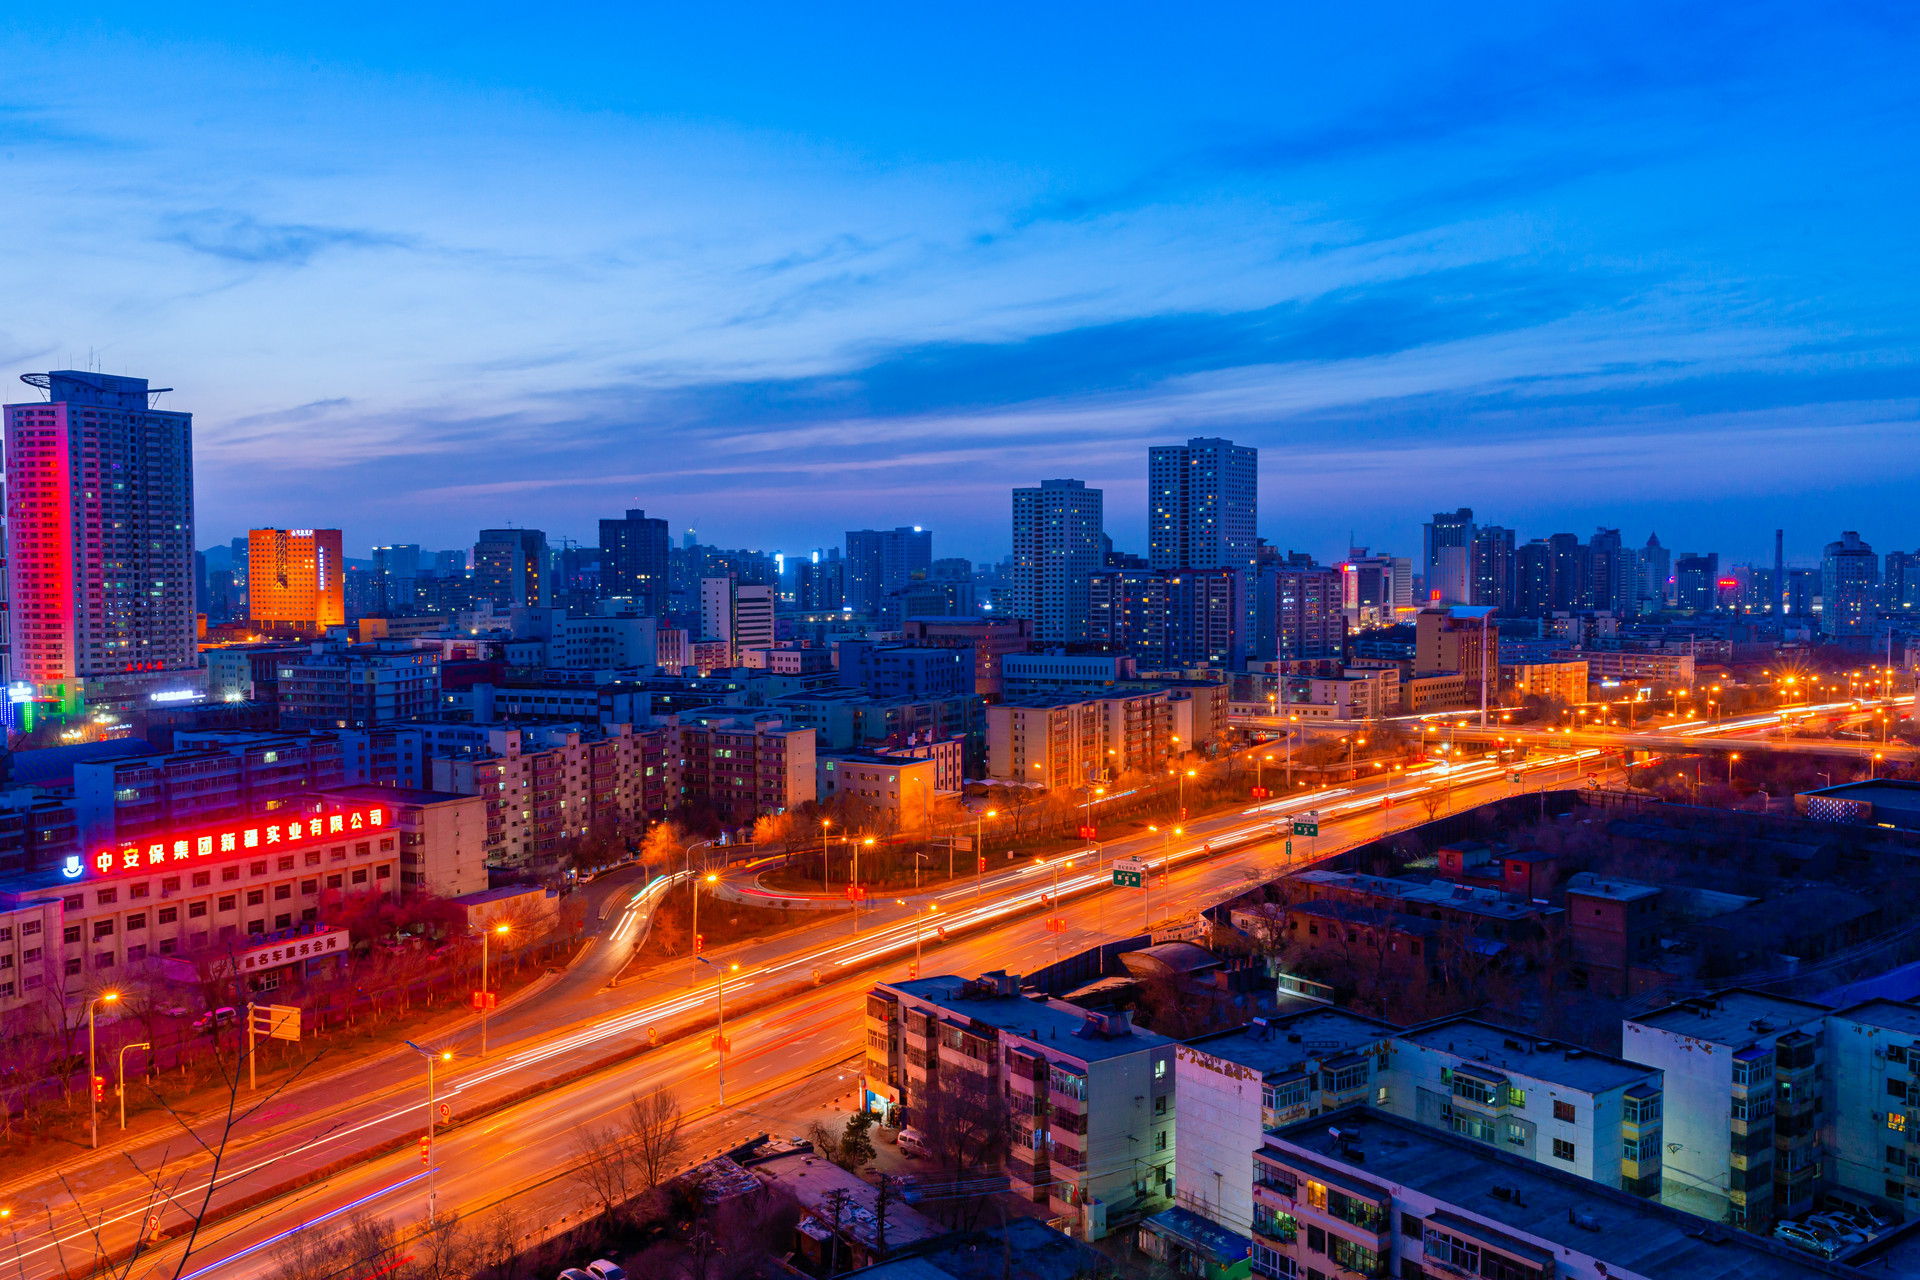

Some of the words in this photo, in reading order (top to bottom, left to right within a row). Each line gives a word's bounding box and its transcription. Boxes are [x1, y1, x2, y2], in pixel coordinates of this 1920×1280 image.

[97, 808, 383, 873] 中安保集团新疆实业有限公司
[215, 937, 337, 974] 名车服务会所
